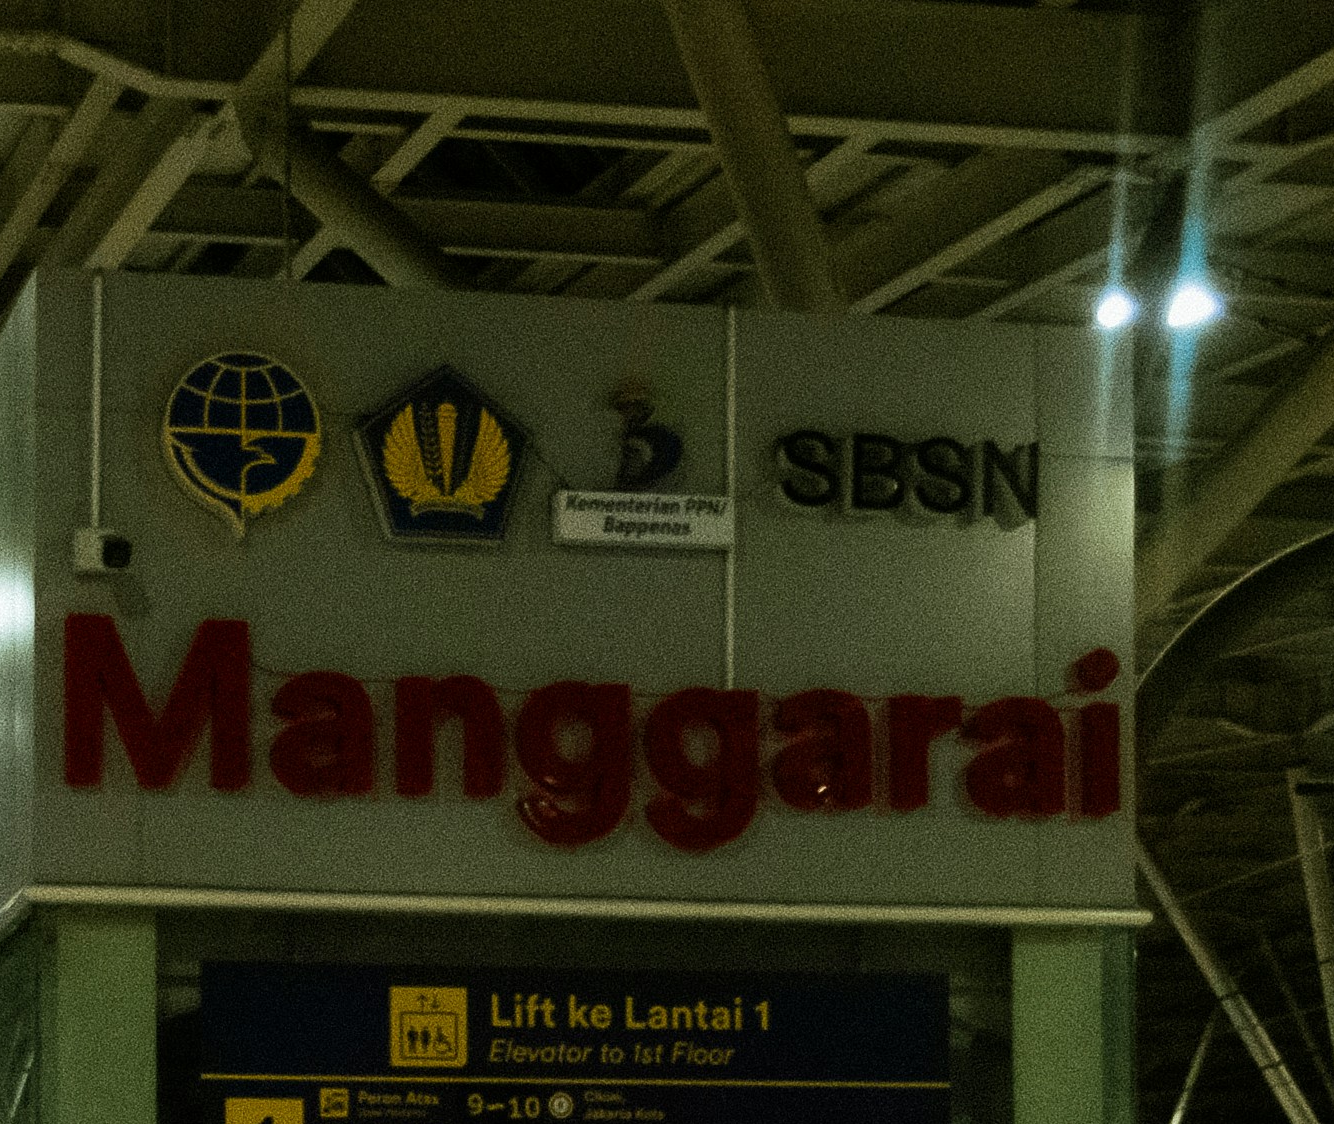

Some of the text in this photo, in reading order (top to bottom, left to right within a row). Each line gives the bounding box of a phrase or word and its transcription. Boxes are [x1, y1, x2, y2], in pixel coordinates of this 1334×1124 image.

[777, 428, 1041, 523] SBSN
[566, 495, 728, 516] Kementerian PPN/
[603, 516, 692, 538] Bappenas
[62, 612, 1122, 851] Manggarai
[490, 992, 770, 1032] Lift ke Lantai 1
[488, 1038, 736, 1066] Elevator to 1st Floor
